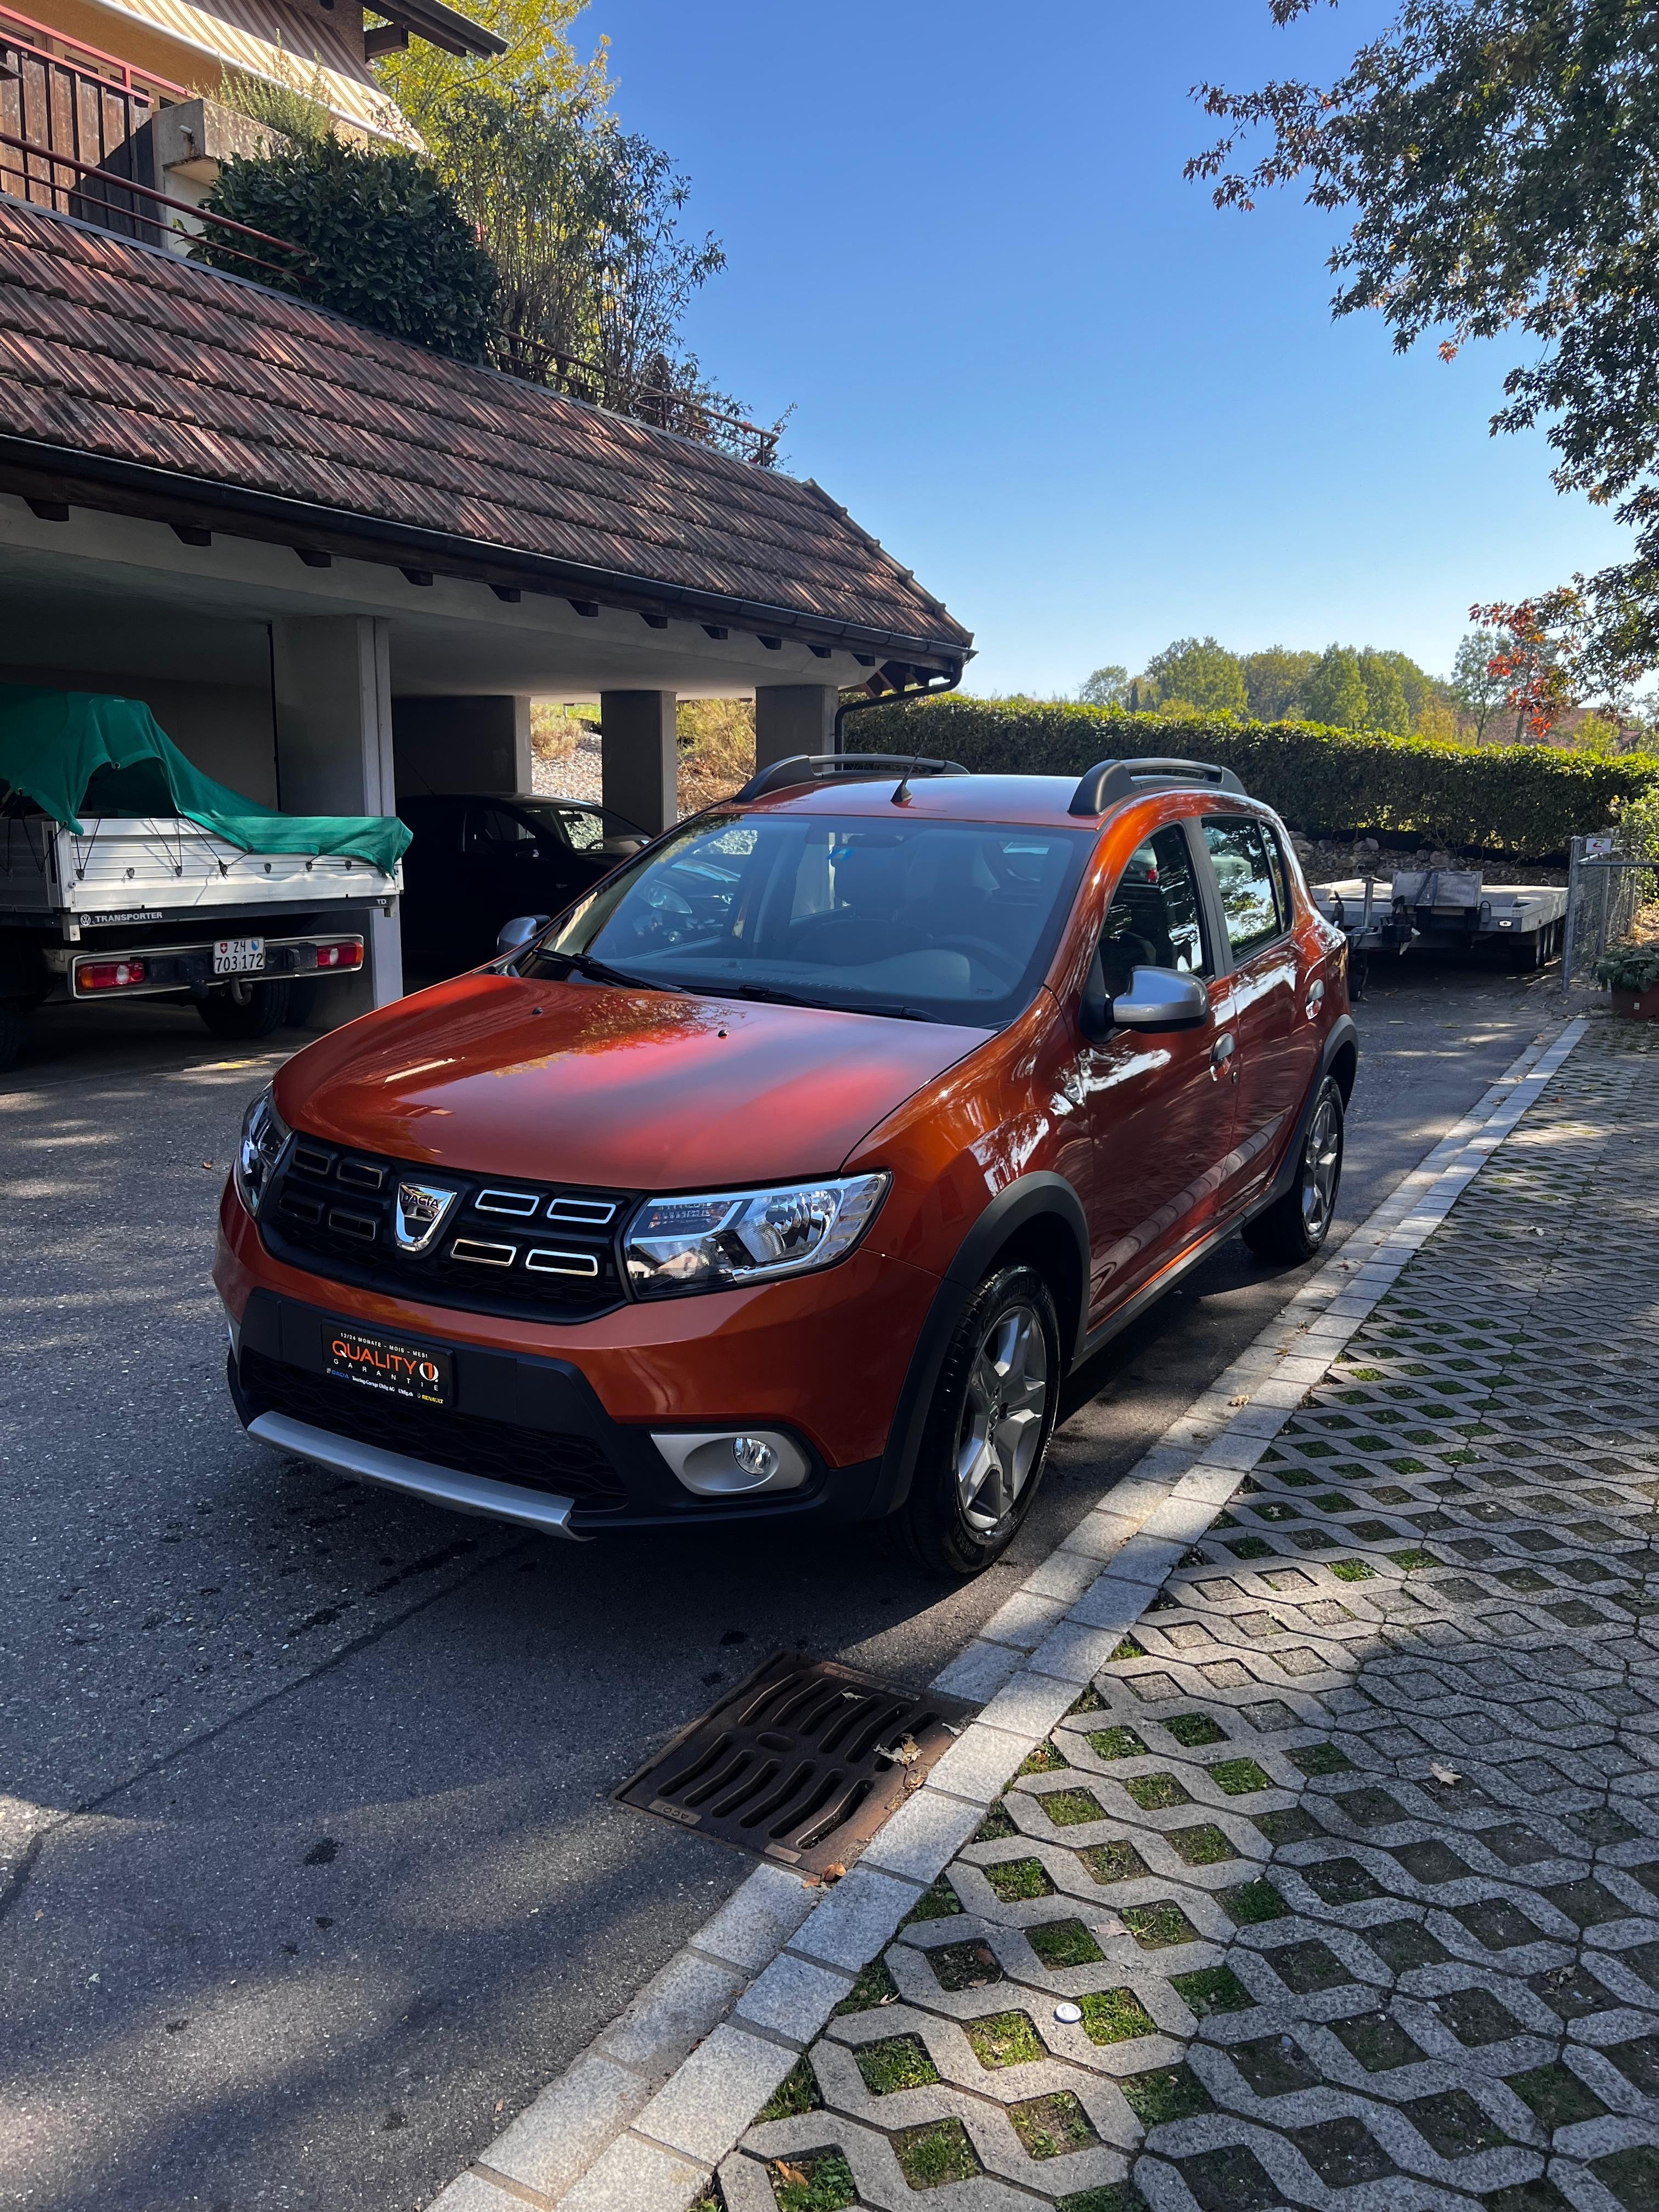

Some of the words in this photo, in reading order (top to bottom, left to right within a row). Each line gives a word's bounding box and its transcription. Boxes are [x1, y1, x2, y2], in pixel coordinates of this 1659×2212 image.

[95, 912, 163, 922] TRANSPORTER
[234, 941, 246, 953] ZH
[403, 1194, 439, 1209] DACIA
[358, 1337, 382, 1347] MONATE
[389, 1345, 404, 1353] MOIS
[413, 1351, 428, 1359] MESI
[332, 1340, 417, 1375] QUALITY
[331, 1370, 349, 1379] DACIA
[334, 1358, 439, 1391] GARANTIE
[421, 1395, 444, 1404] RENAULT
[663, 1807, 690, 1819] ACO
